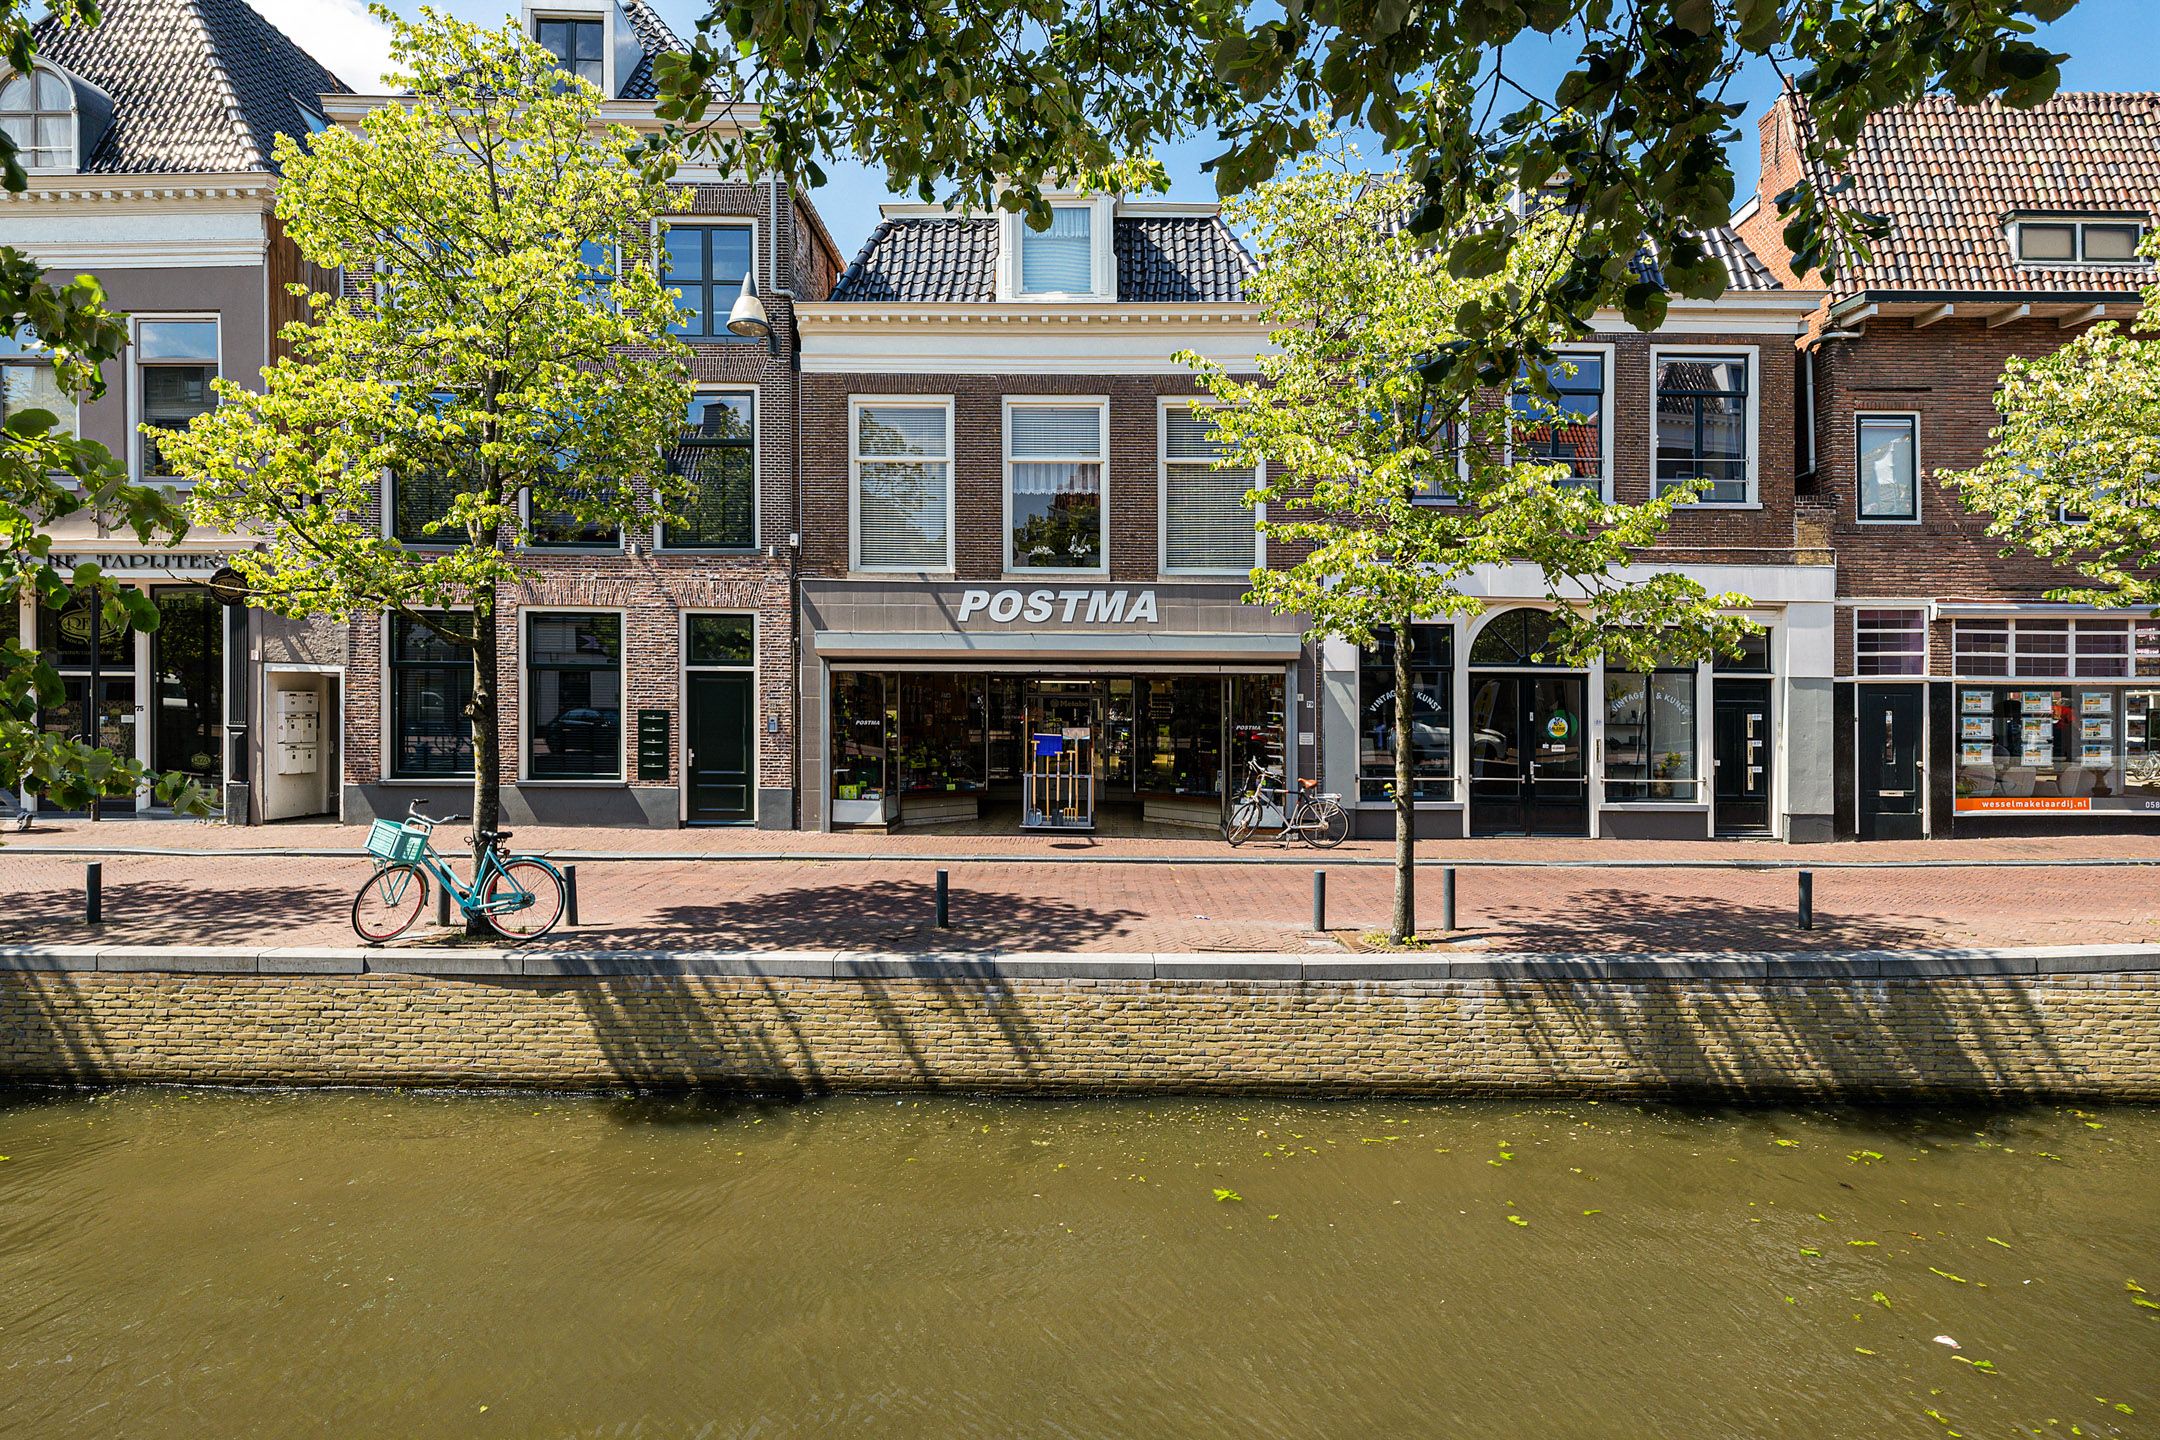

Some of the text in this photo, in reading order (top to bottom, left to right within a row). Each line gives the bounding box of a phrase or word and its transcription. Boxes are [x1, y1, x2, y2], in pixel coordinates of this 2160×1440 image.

[97, 554, 221, 568] TAPIJTEN
[957, 590, 1159, 623] POSTMA
[1416, 692, 1442, 712] KUNST
[1611, 691, 1689, 715] VINTAGE & KUNST
[1981, 800, 2087, 809] wesselmakelaardij.nl
